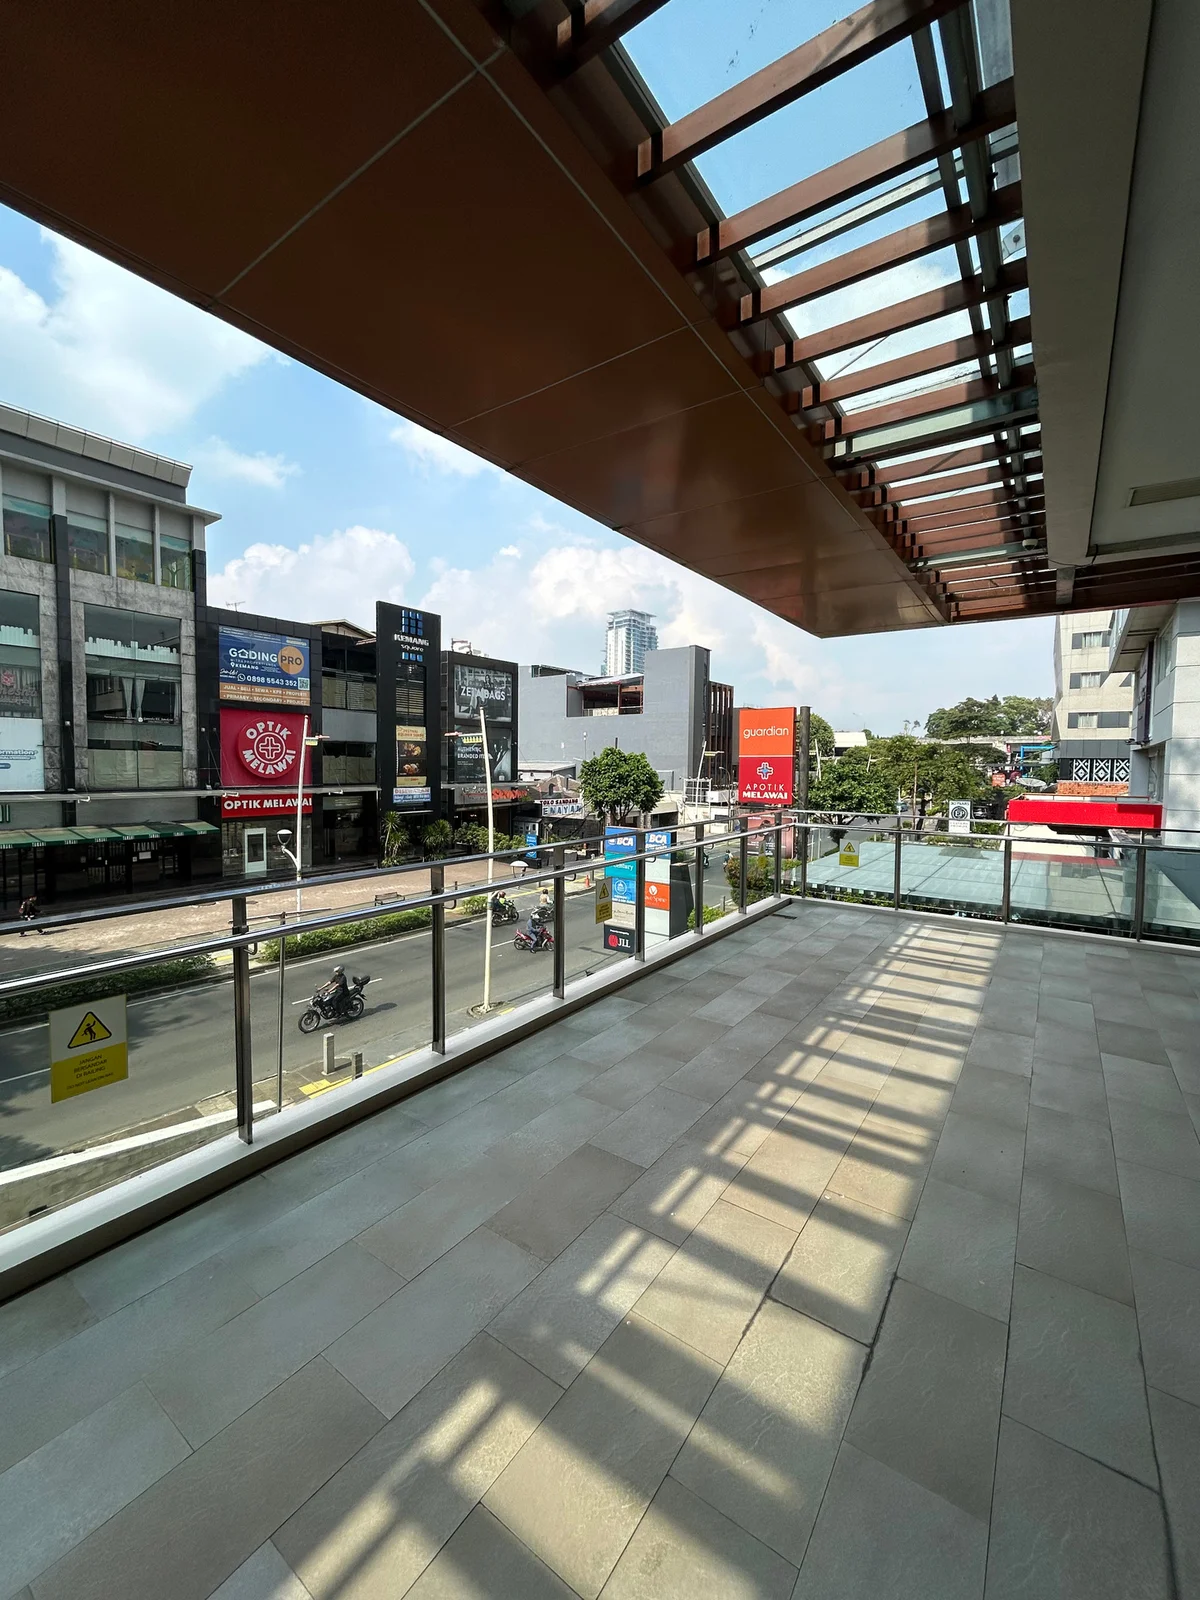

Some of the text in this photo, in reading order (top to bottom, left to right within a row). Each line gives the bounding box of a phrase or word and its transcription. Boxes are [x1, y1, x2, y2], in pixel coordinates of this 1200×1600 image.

[394, 634, 429, 646] KEMANG
[281, 655, 302, 666] PRO
[246, 675, 265, 683] 0898
[285, 679, 297, 687] 352
[484, 689, 506, 701] BAGS
[246, 721, 292, 740] OPTIK
[743, 726, 789, 739] guardian
[242, 749, 296, 775] MELAWAI
[746, 783, 785, 791] APOTIK
[742, 791, 788, 800] MELAWAI
[224, 797, 312, 810] OPTIK MELAWAI
[616, 837, 634, 847] BCA
[649, 833, 667, 845] BCA
[618, 937, 631, 949] JLL
[79, 1054, 103, 1066] JANGAN
[73, 1059, 108, 1074] BERSANDAR
[83, 1066, 106, 1077] RAILING
